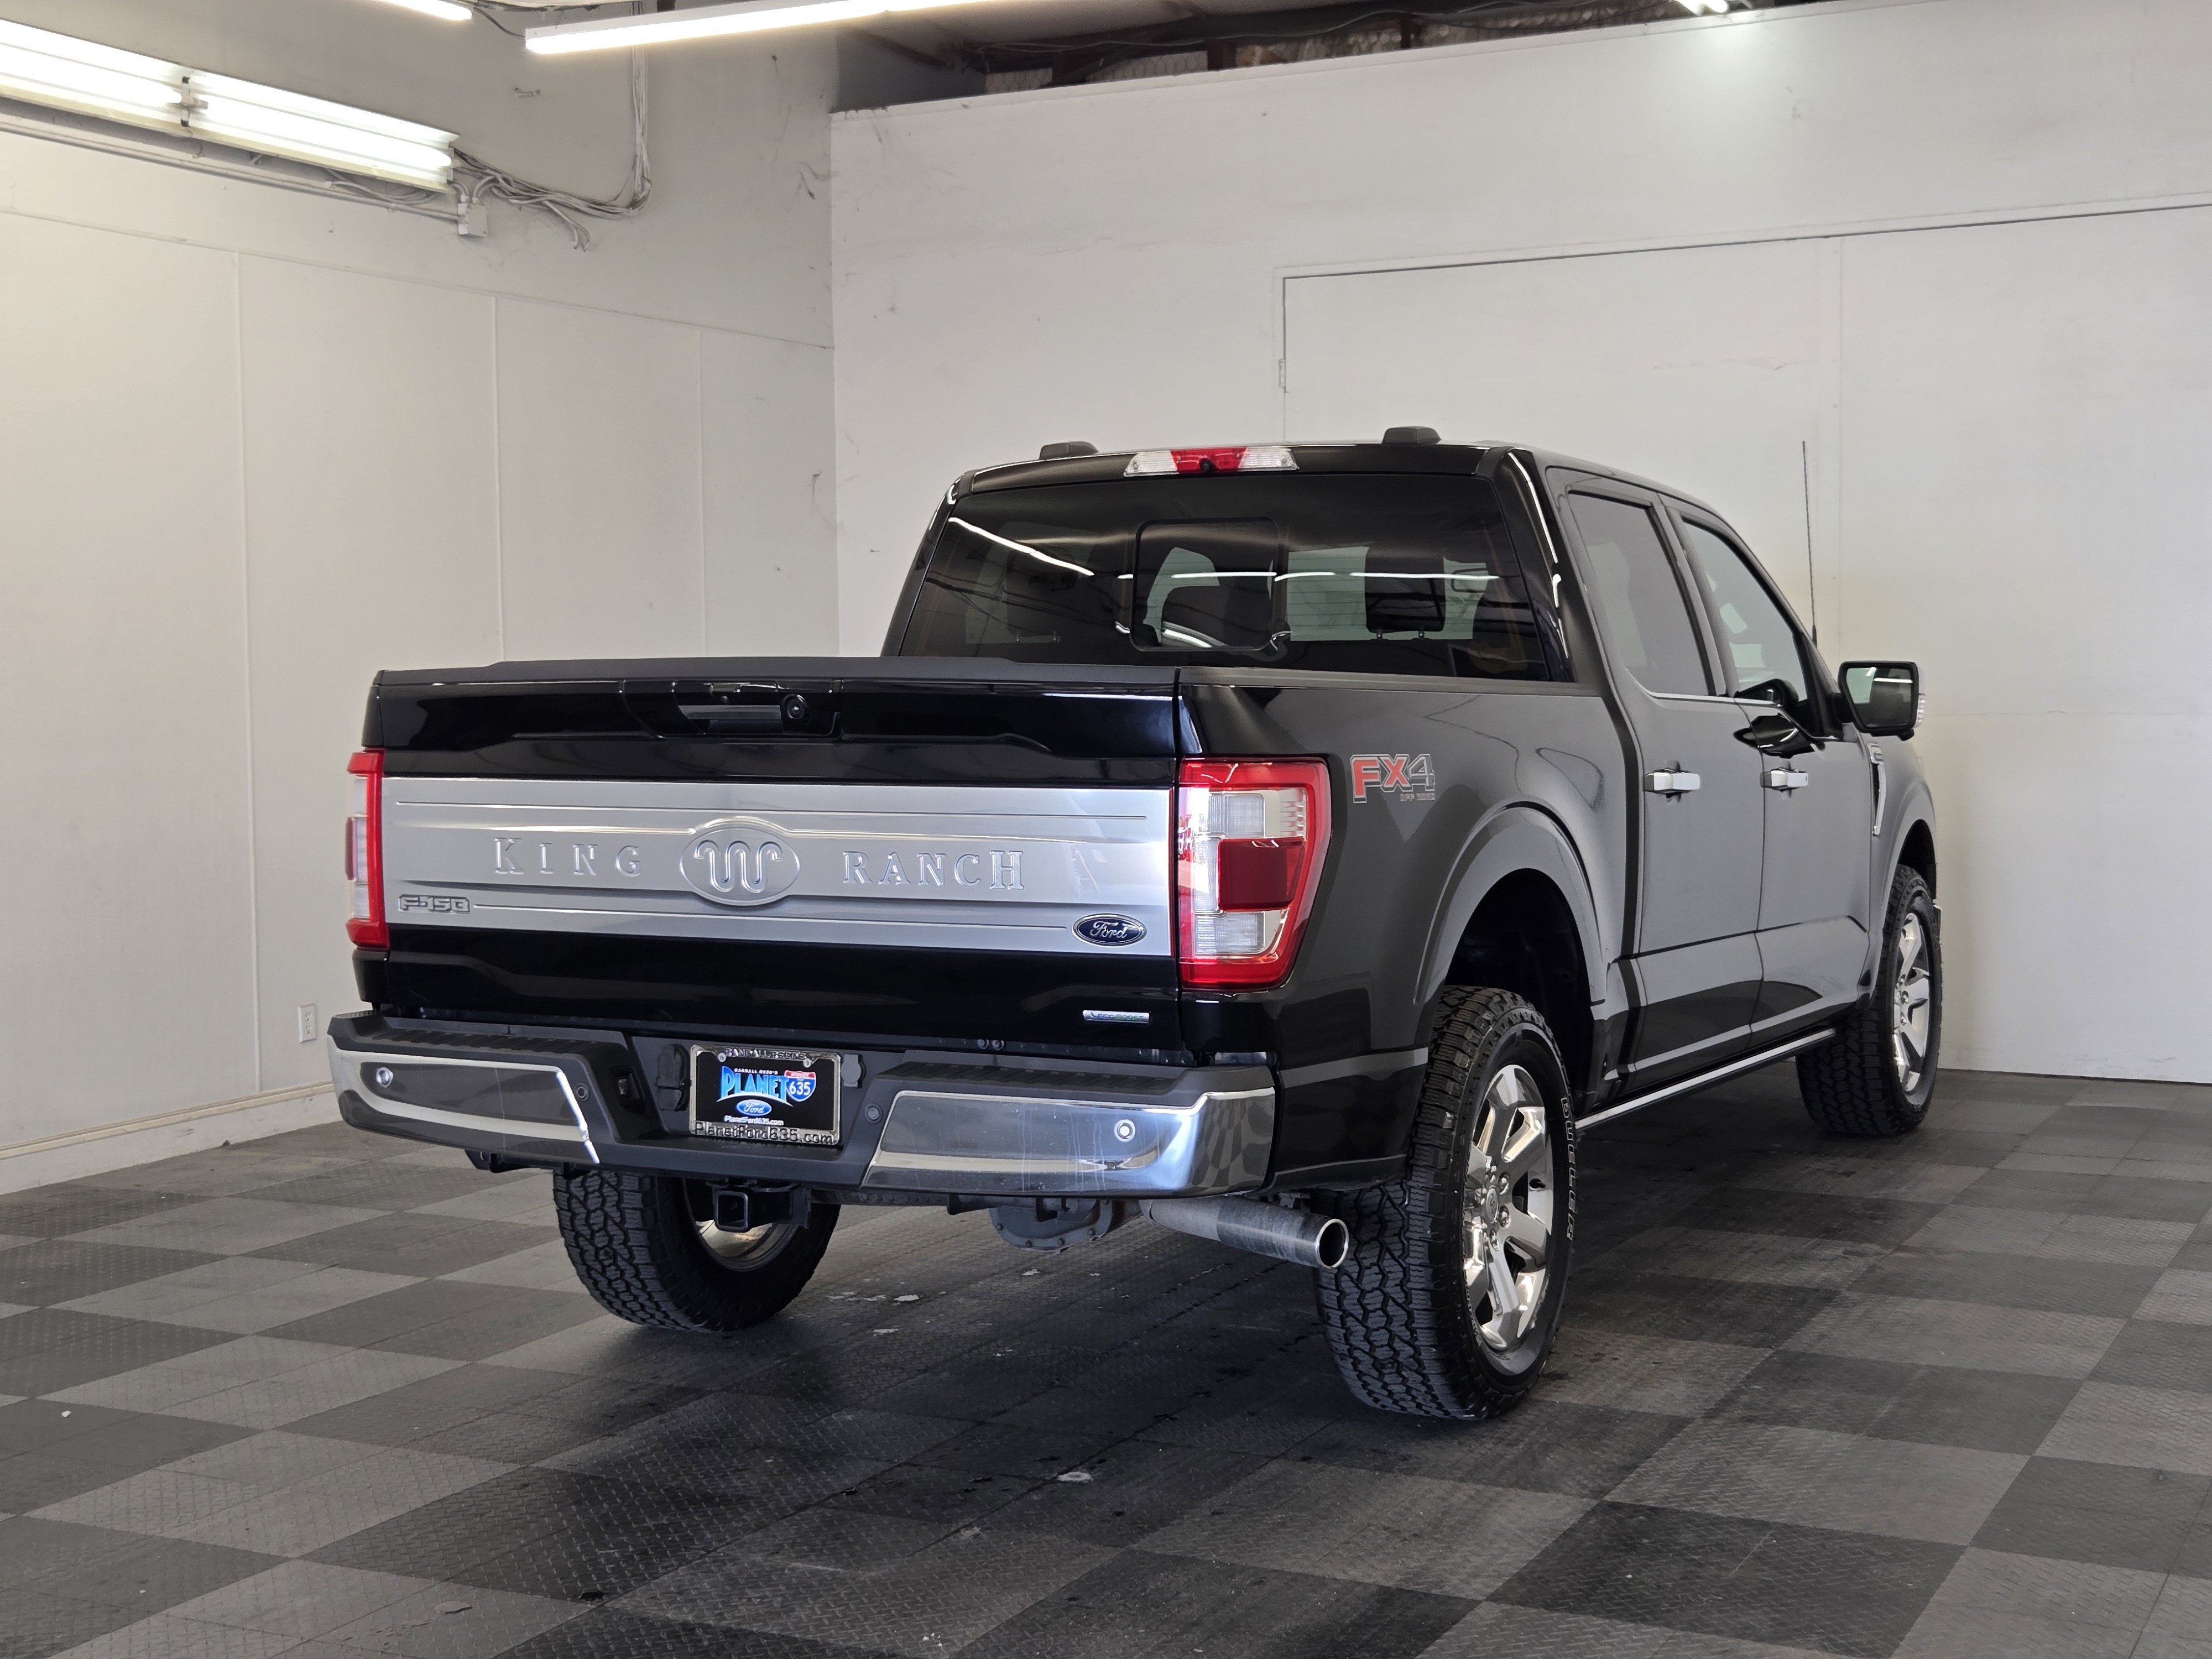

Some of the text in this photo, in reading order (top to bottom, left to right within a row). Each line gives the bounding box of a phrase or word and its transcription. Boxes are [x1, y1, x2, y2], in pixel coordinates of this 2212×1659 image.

[1350, 754, 1435, 803] FX4
[494, 837, 1024, 890] KING RANCH
[398, 894, 471, 913] F-150
[1089, 922, 1129, 938] Ford
[721, 1066, 789, 1102] PLANET
[789, 1081, 811, 1095] 635
[743, 1102, 765, 1114] Ford
